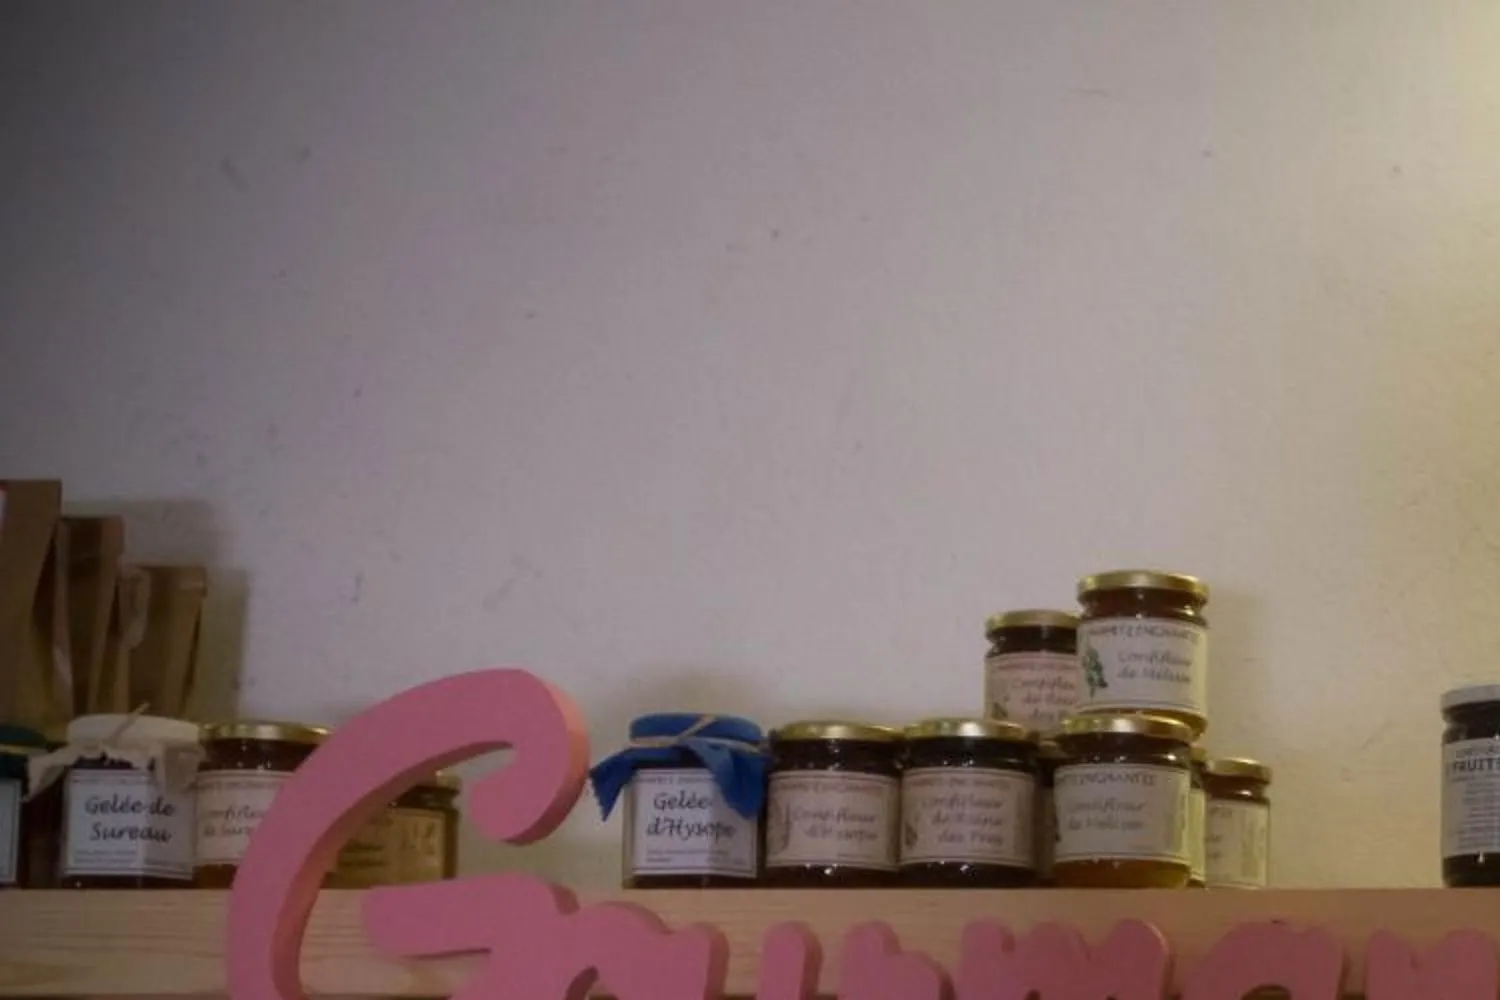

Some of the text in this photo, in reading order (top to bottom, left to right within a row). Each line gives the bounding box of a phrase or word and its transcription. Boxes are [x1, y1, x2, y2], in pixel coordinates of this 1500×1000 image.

[85, 792, 175, 817] Gelée de
[653, 790, 710, 811] Gelée
[89, 821, 173, 843] Sureau
